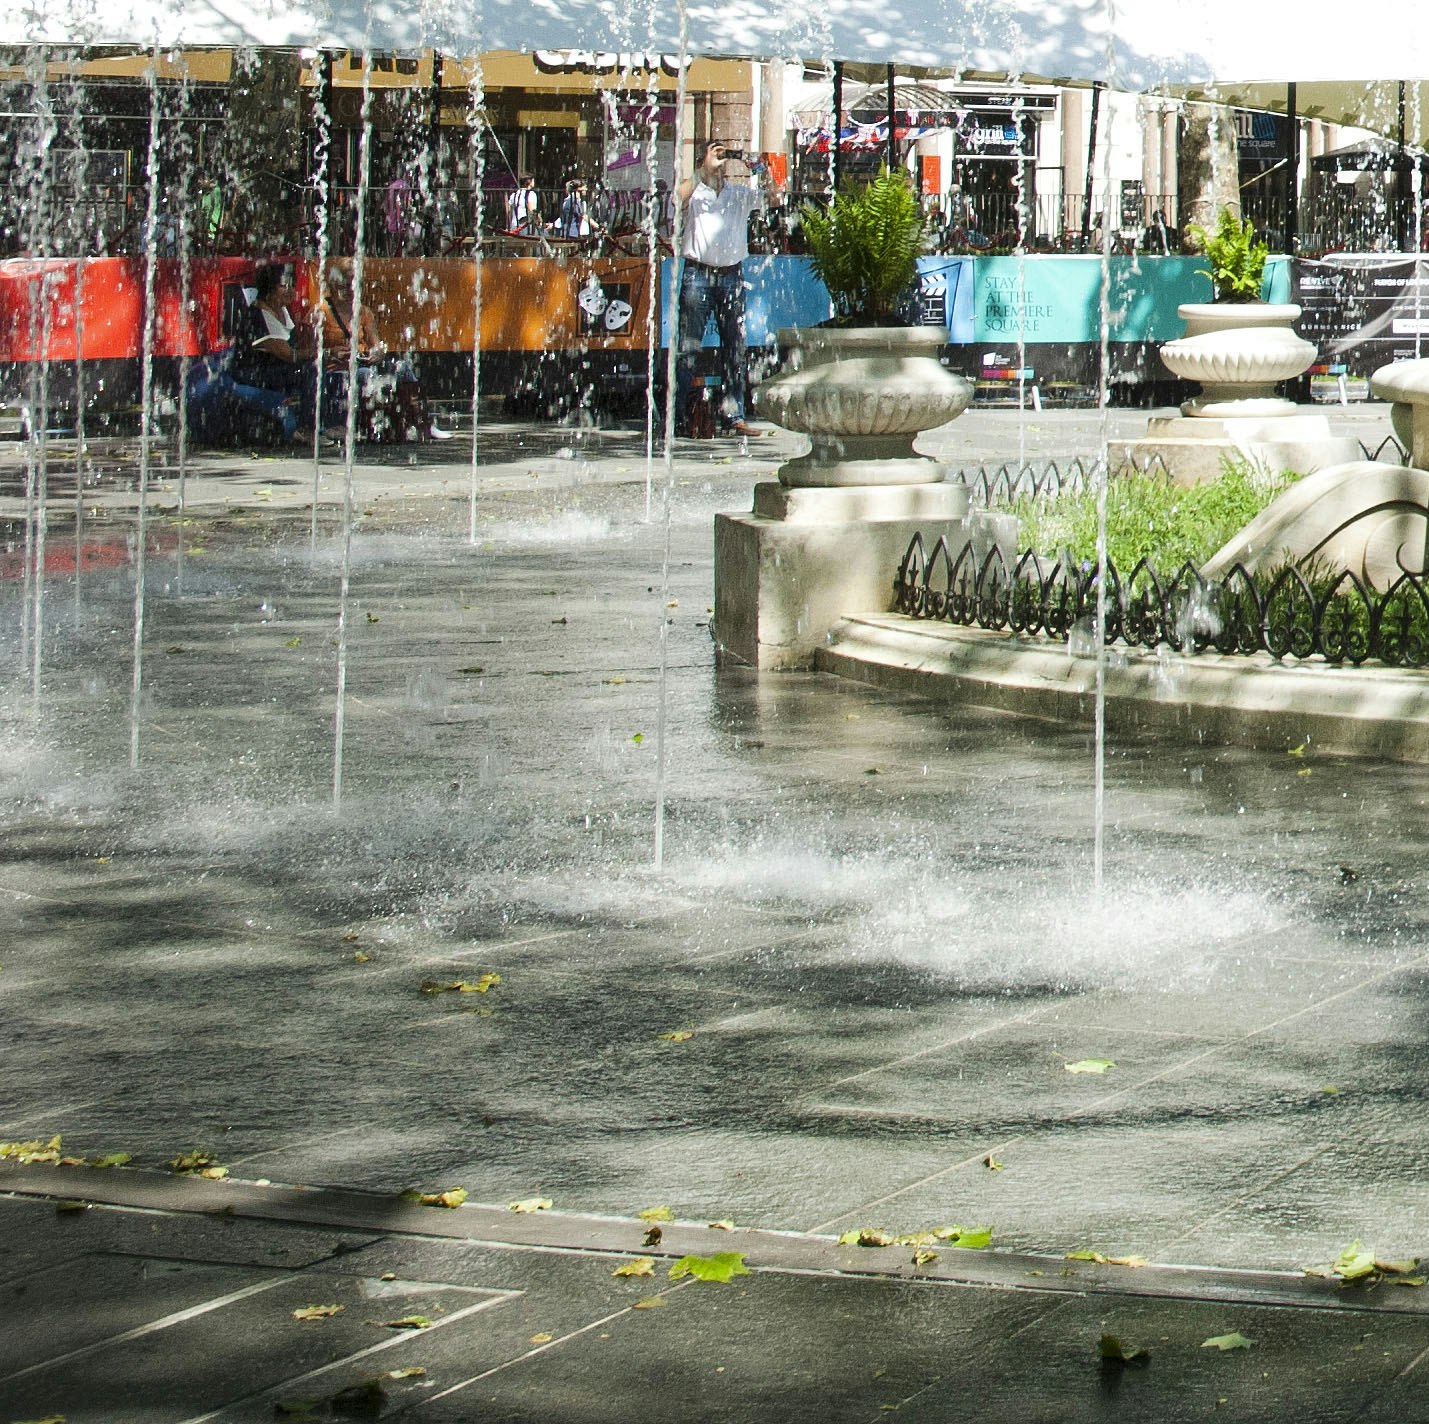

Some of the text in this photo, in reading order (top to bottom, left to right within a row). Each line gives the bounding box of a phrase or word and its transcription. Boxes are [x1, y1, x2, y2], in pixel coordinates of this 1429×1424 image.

[984, 276, 1017, 289] STAY
[986, 290, 1035, 303] AT THE
[985, 305, 1055, 318] PREMIERE
[984, 319, 1040, 334] SQUARE
